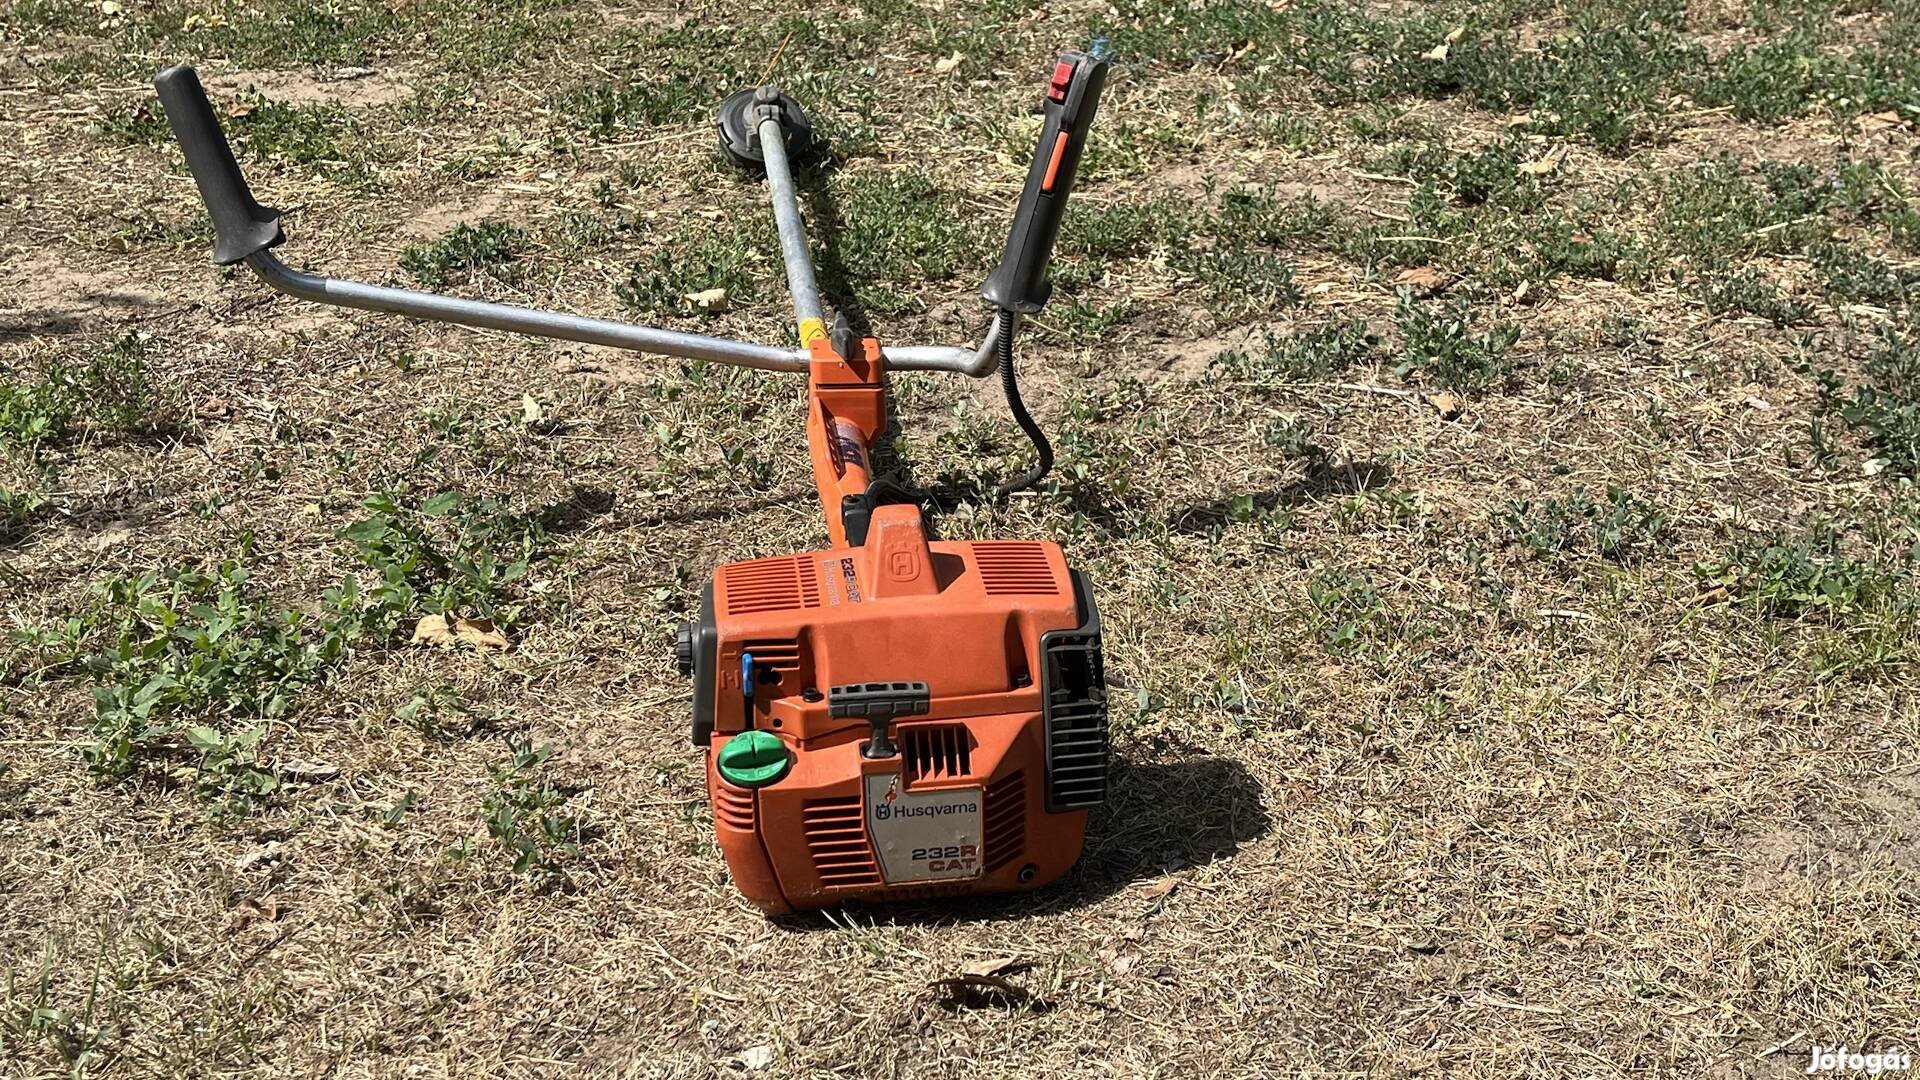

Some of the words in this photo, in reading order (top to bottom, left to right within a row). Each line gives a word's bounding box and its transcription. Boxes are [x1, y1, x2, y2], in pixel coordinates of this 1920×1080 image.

[894, 802, 977, 818] Husqvarna
[912, 845, 977, 860] 232R
[928, 858, 977, 872] CAT
